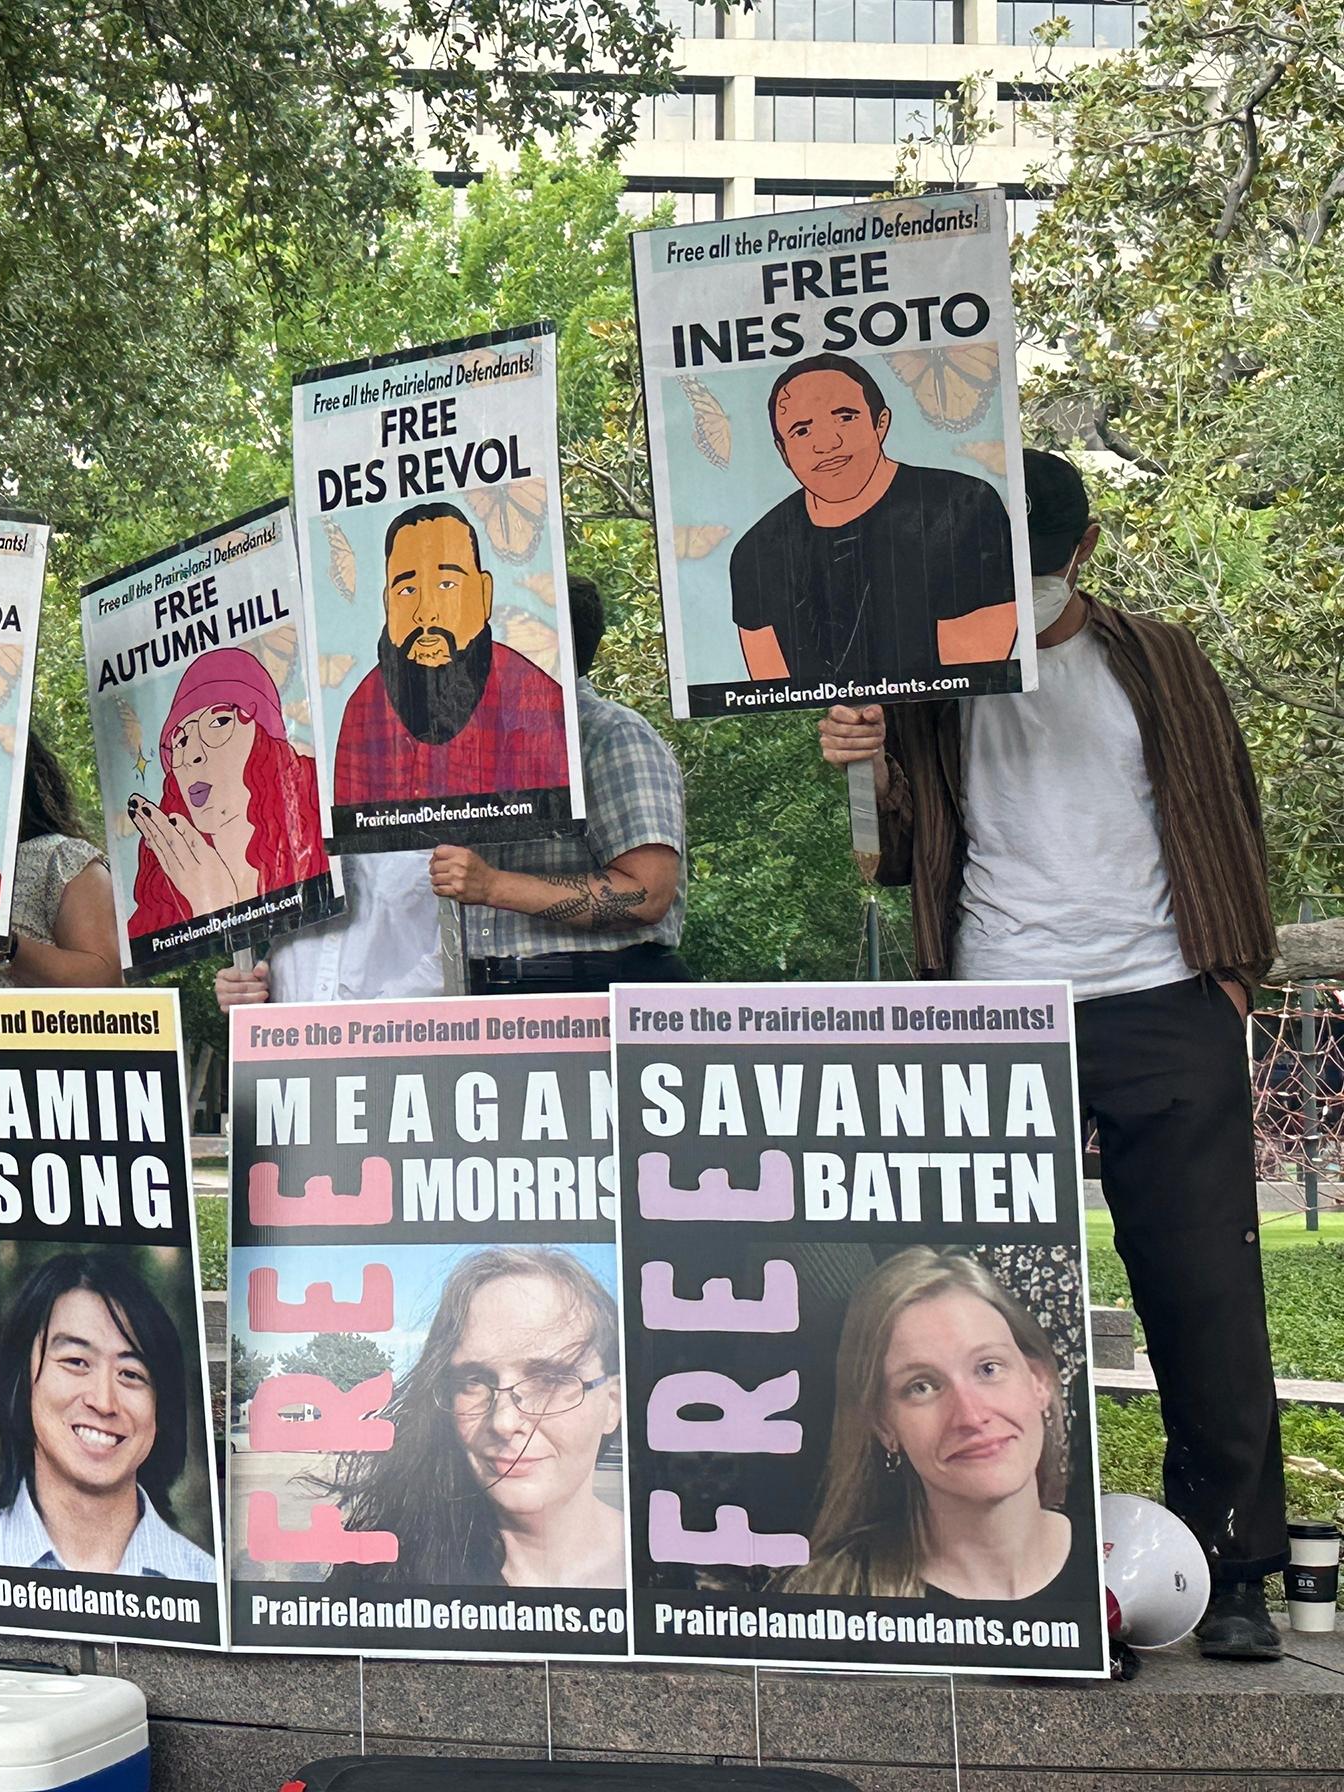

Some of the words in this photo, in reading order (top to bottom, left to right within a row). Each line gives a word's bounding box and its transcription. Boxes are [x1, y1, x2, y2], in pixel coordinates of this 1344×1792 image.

[667, 240, 704, 264] Free
[708, 234, 730, 259] all
[734, 234, 763, 256] the
[767, 218, 866, 252] Prairieland
[871, 204, 980, 240] Defendants!
[762, 250, 890, 305] FREE
[672, 312, 805, 368] INES
[822, 292, 991, 352] SOTO
[314, 393, 340, 414] Free
[342, 385, 357, 407] all
[360, 386, 380, 404] the
[382, 366, 453, 400] Prairieland
[456, 349, 534, 386] Defendants!
[381, 398, 456, 448] FREE
[318, 458, 386, 512] DES
[398, 434, 531, 498] REVOL
[98, 597, 120, 616] Free
[122, 584, 136, 606] all
[136, 580, 152, 598] the
[154, 557, 212, 591] Prairieland
[214, 522, 276, 566] Defendants!
[154, 576, 218, 630] FREE
[98, 615, 220, 692] AUTUMN
[227, 588, 290, 638] HILL
[724, 674, 970, 708] PrairielandDefendants.com
[355, 802, 533, 828] PrairielandDefendants.com
[152, 894, 303, 952] PrairielandDefendants.com
[32, 1010, 160, 1034] Defendants!
[250, 1024, 299, 1048] Free
[304, 1022, 342, 1046] the
[348, 1018, 480, 1044] Prairieland
[629, 1007, 684, 1032] Free
[690, 1007, 732, 1032] the
[738, 1006, 884, 1032] Prairieland
[892, 1004, 1054, 1032] Defendants!
[640, 1062, 1056, 1138] SAVANNA
[802, 1152, 1057, 1224] BATTEN
[247, 1156, 399, 1565] FREE
[637, 1148, 810, 1568] FREE
[251, 1596, 626, 1634] PrairielandDefendants.co
[654, 1602, 1080, 1648] PrairielandDefendants.com
